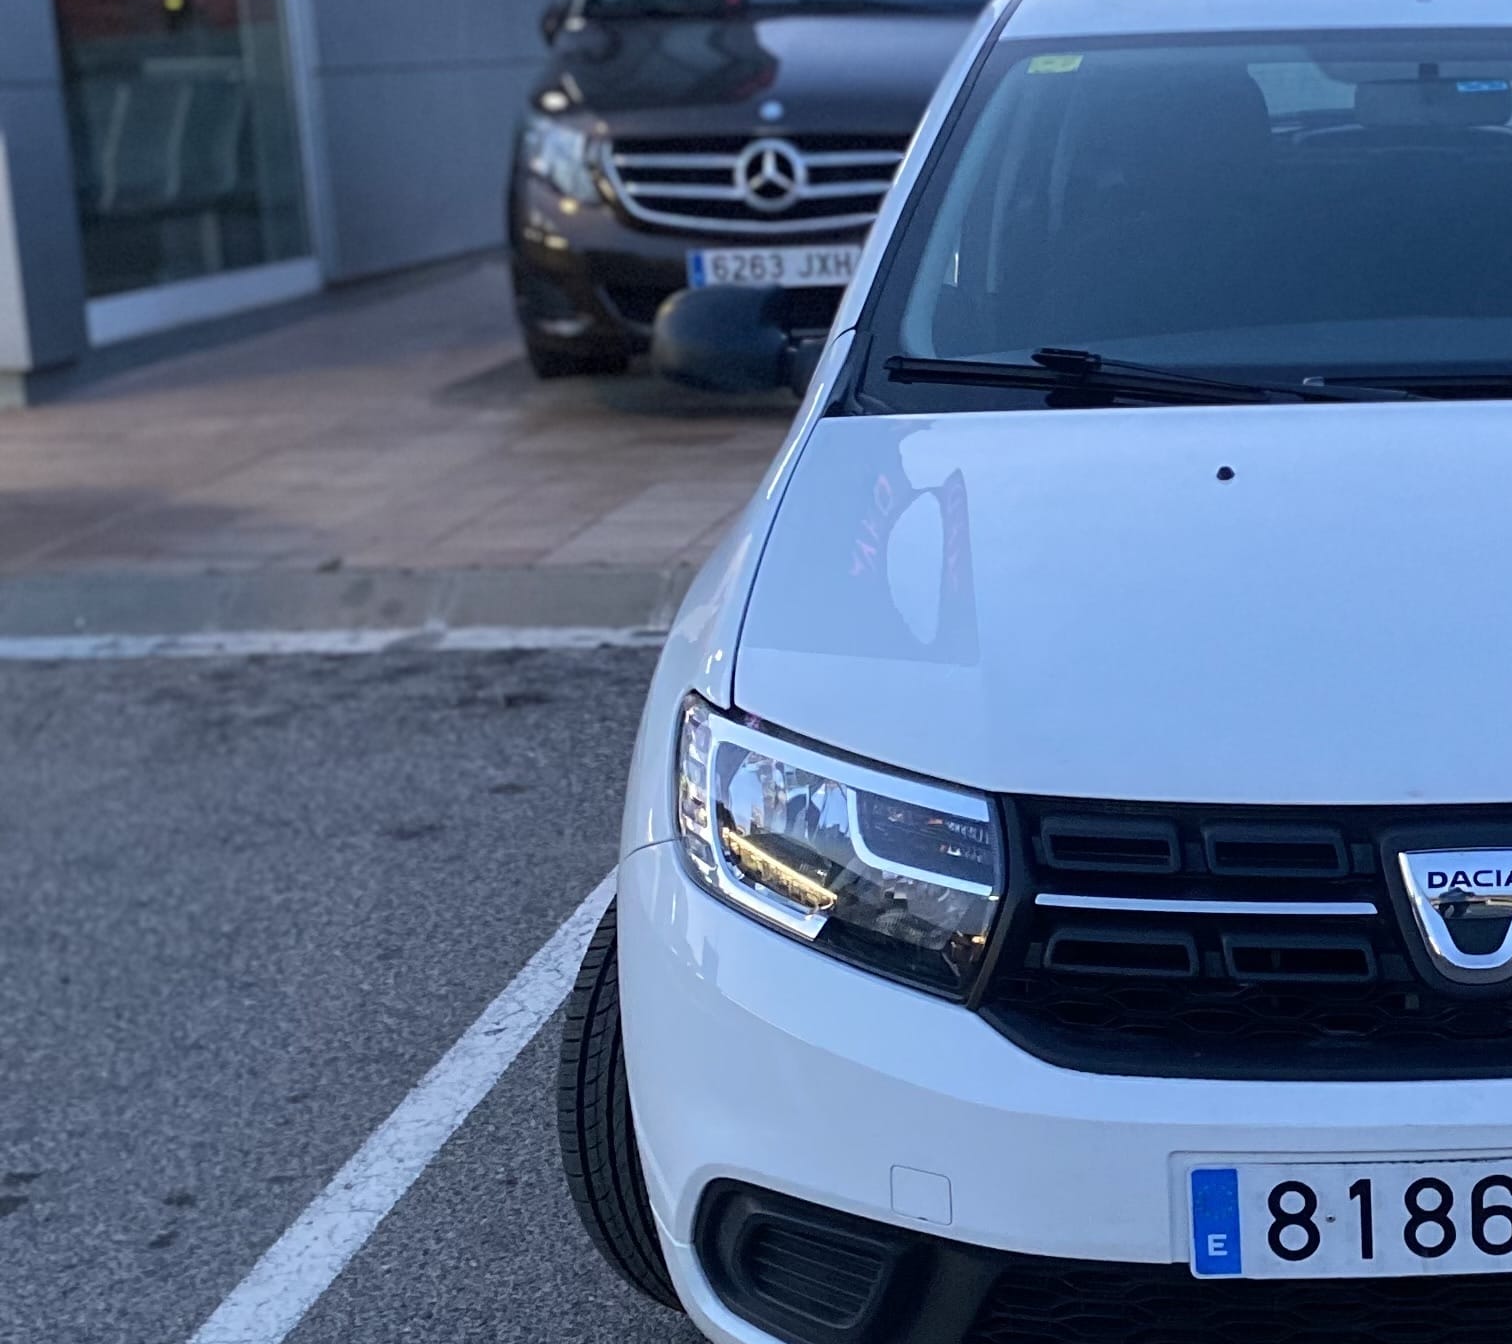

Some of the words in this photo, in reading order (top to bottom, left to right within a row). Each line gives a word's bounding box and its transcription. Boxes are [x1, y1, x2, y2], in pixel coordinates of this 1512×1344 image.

[710, 252, 785, 281] 6263
[799, 250, 853, 278] JXH
[1207, 1233, 1229, 1257] E
